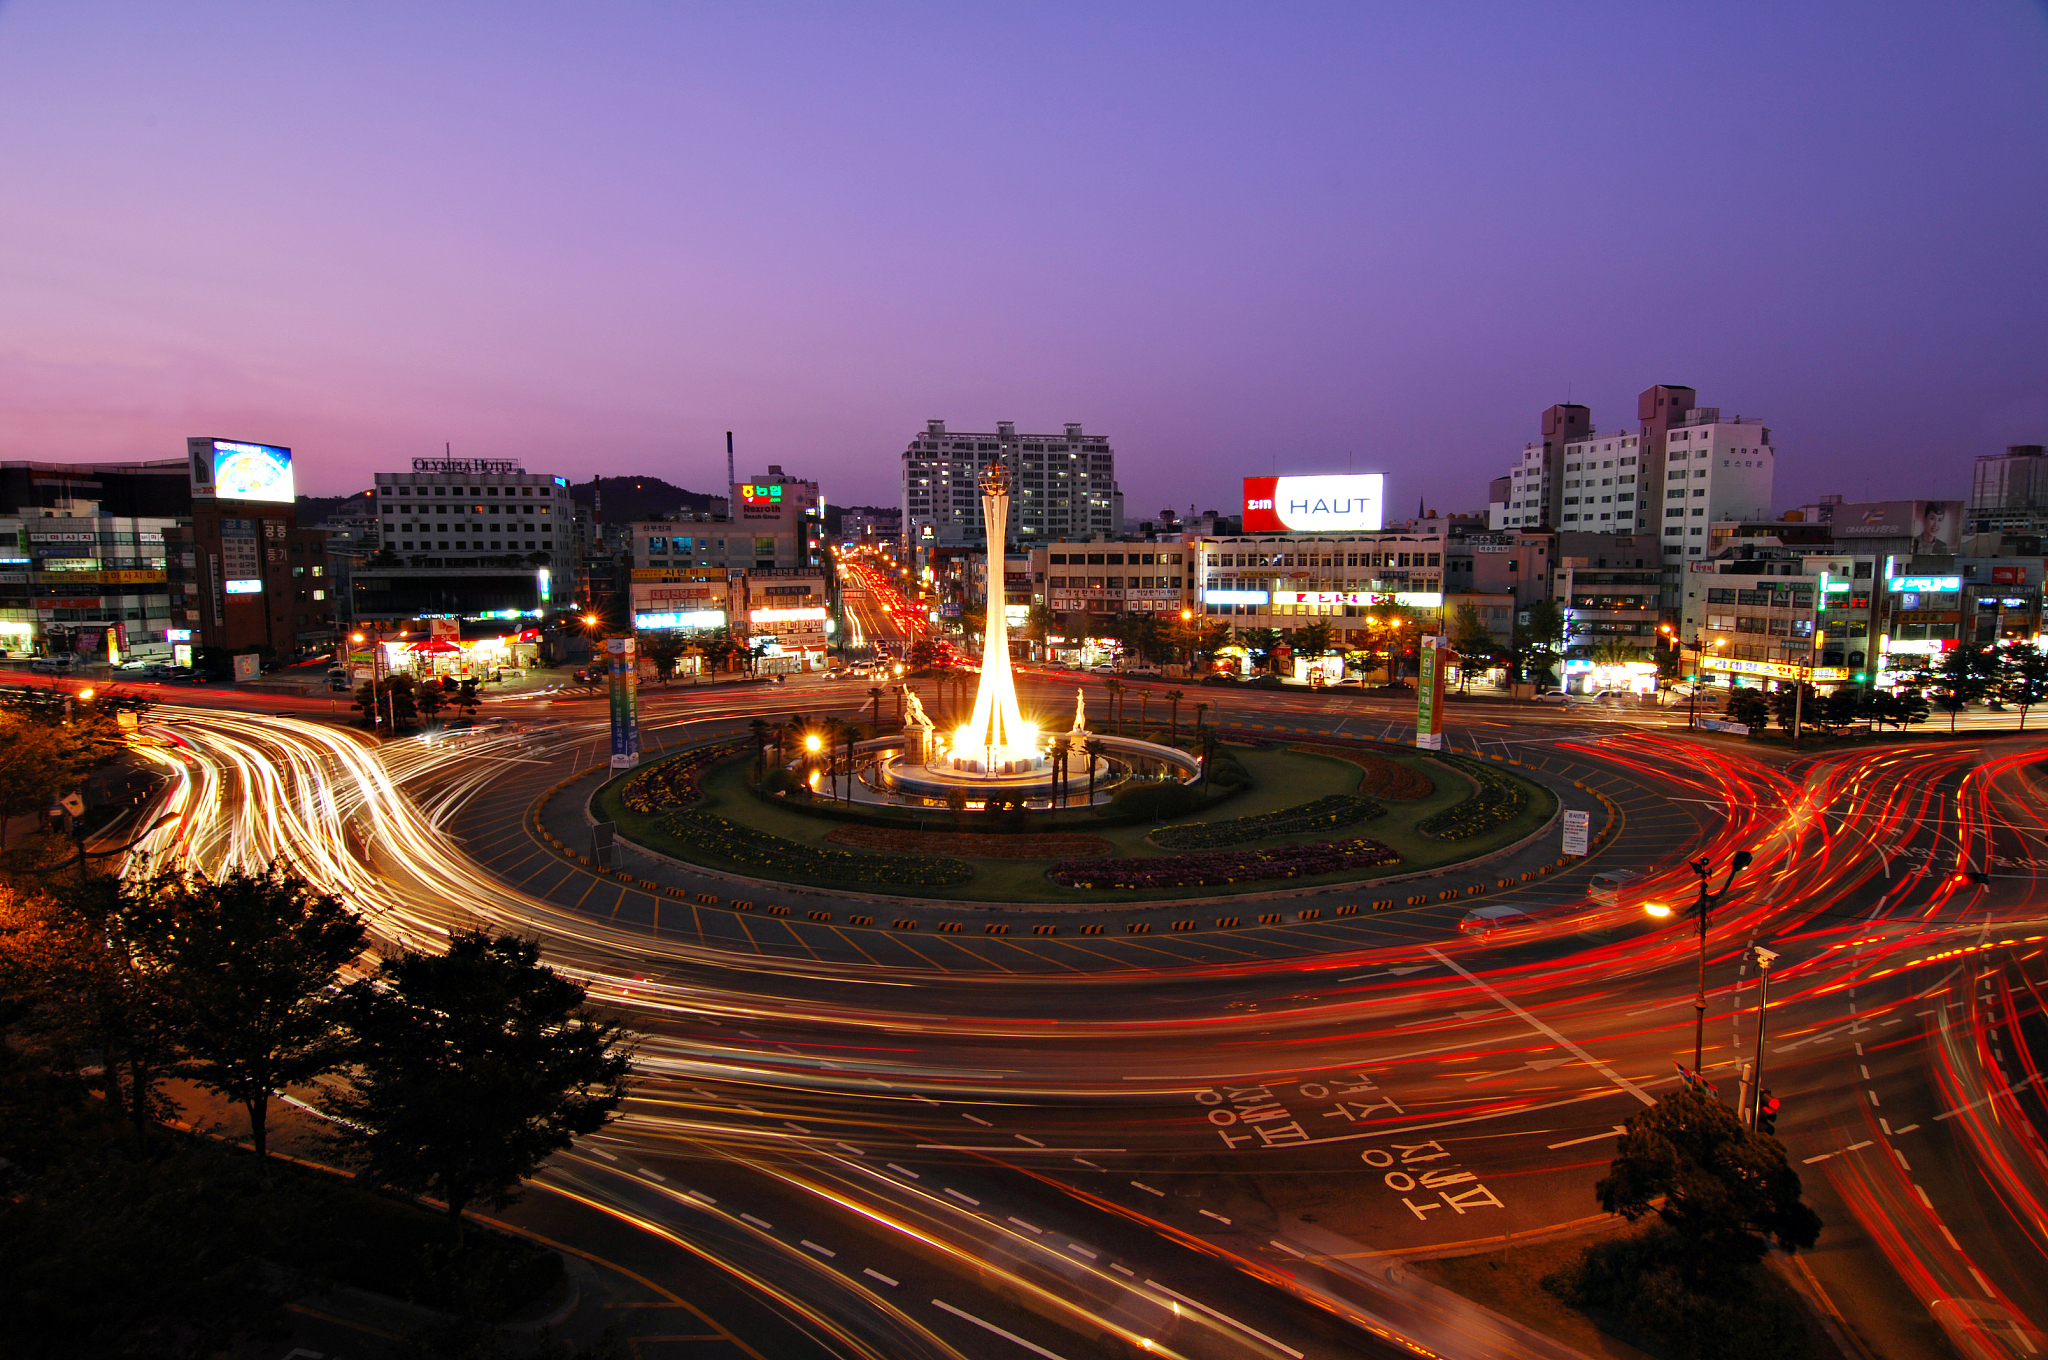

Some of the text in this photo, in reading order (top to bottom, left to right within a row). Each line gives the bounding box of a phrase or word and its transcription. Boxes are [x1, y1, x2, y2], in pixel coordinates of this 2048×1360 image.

[413, 458, 517, 472] OLYMPIA HOTEL
[756, 485, 782, 497] 농협
[743, 504, 780, 513] Rexroth
[1290, 498, 1371, 514] HAUT
[264, 525, 287, 538] 공증
[1845, 525, 1899, 533] 아시아나항공
[267, 548, 288, 561] 등기
[111, 571, 143, 580] 마사지
[665, 569, 687, 577] 시민
